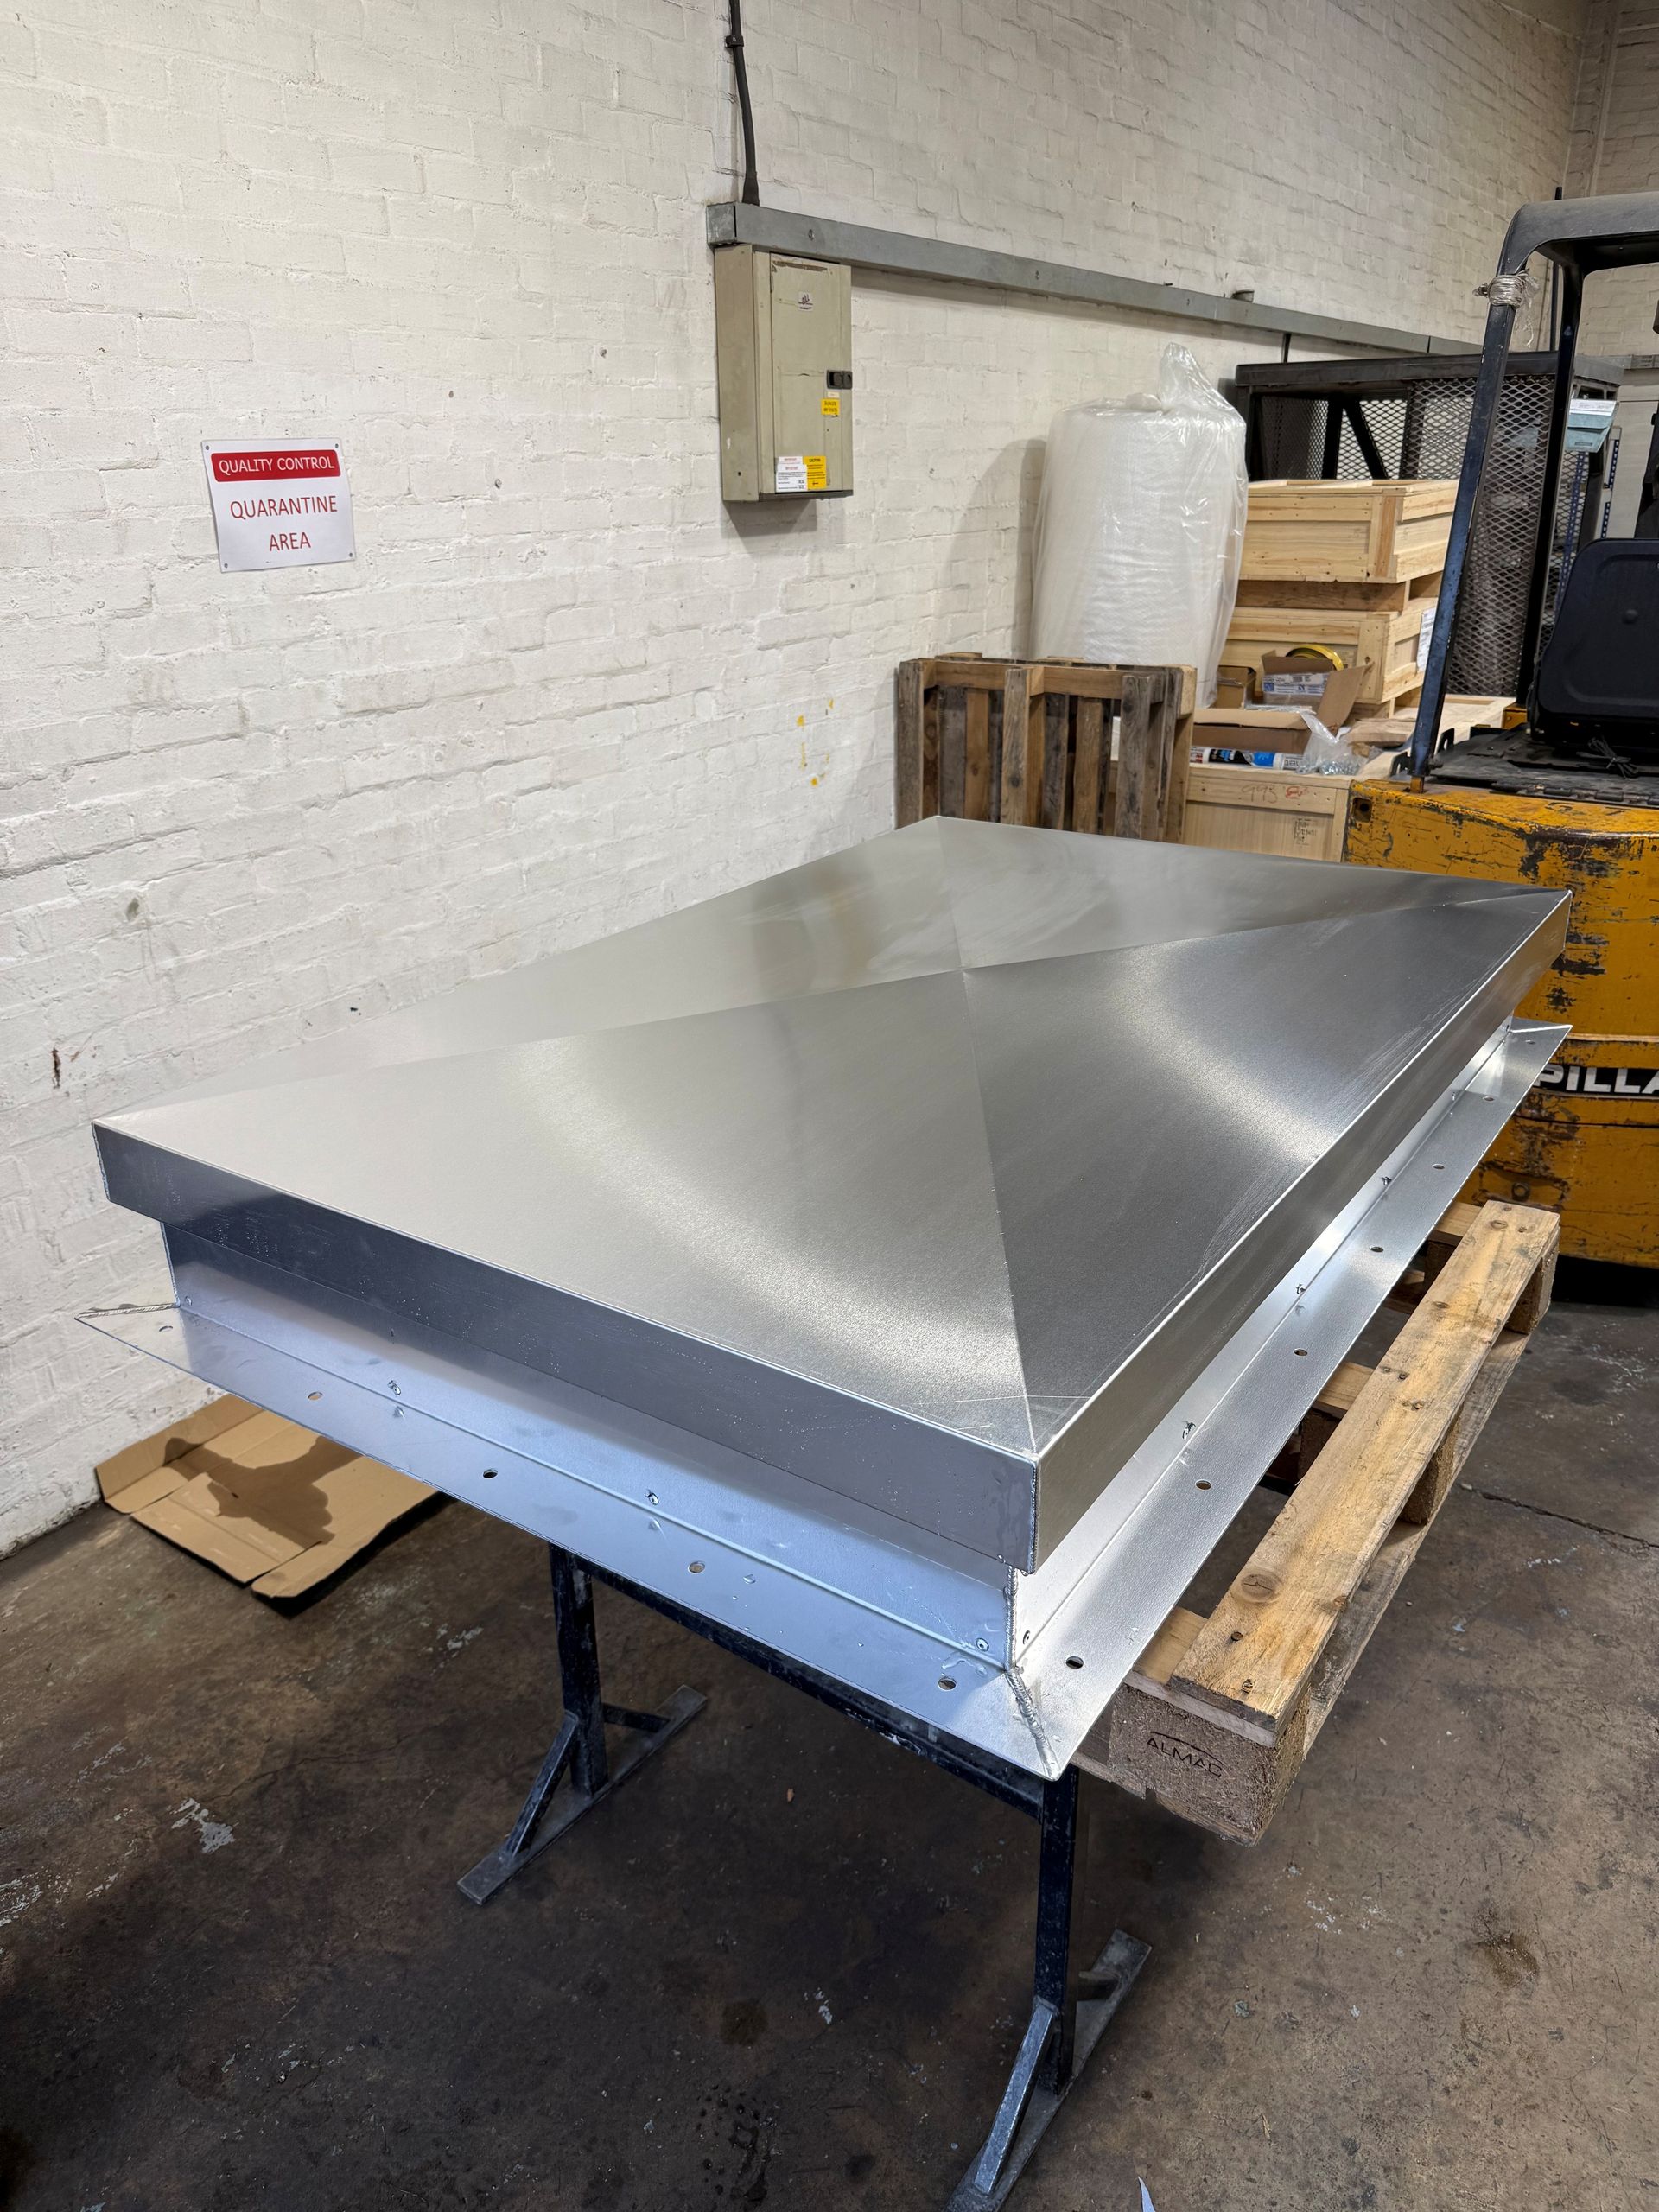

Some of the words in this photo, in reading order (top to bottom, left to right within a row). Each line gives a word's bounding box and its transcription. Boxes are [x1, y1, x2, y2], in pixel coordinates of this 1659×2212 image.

[219, 458, 273, 475] QUALITY
[276, 456, 334, 471] CONTROL
[230, 495, 338, 520] QUARANTINE
[269, 531, 311, 551] AREA
